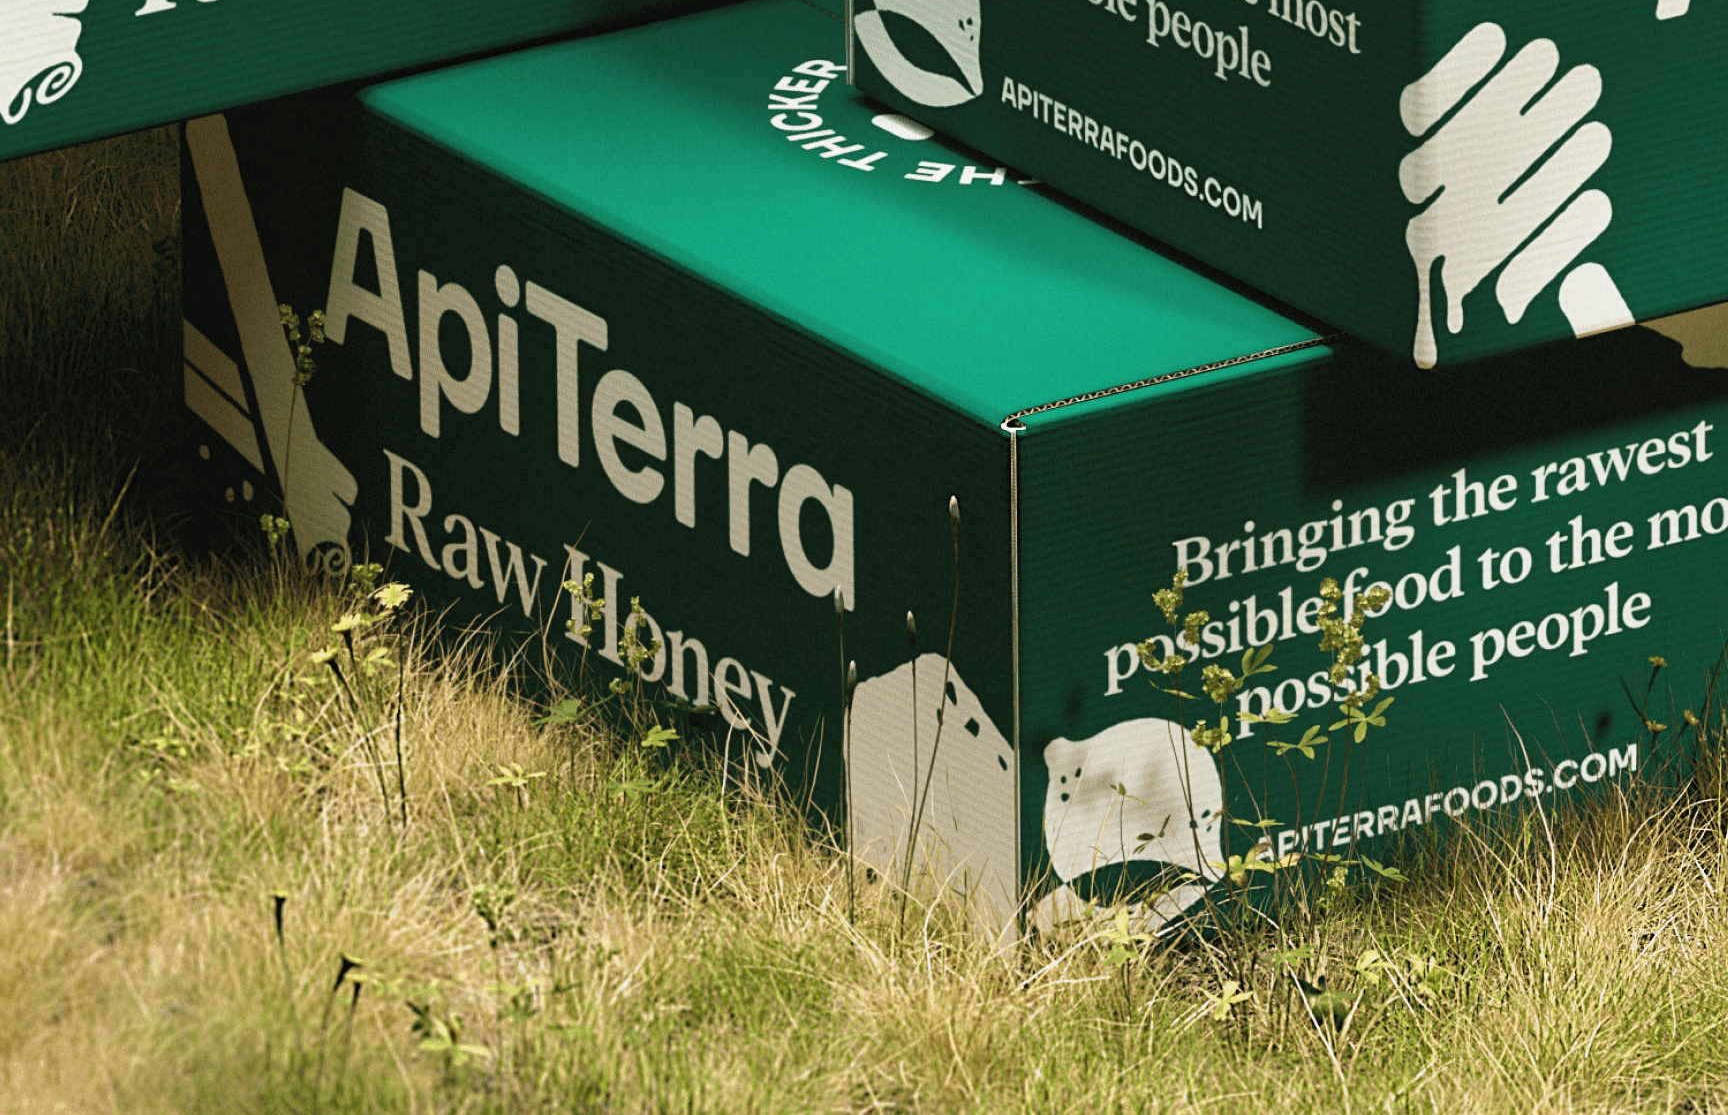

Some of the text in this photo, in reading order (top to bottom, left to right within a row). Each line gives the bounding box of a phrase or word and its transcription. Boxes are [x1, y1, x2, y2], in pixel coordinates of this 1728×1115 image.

[768, 59, 1040, 186] HE THICKER
[1001, 75, 1263, 230] APITERRAFOODS.COM
[325, 186, 856, 612] ApiTerra
[1172, 420, 1714, 589] Bringing the rawest
[383, 448, 797, 769] Raw Honey
[1103, 586, 1325, 697] possible
[1341, 544, 1465, 626] food
[1477, 546, 1533, 590] to
[1545, 514, 1635, 574] the
[1469, 581, 1652, 682] people
[1253, 742, 1638, 862] APITERRAFOODS.COM
